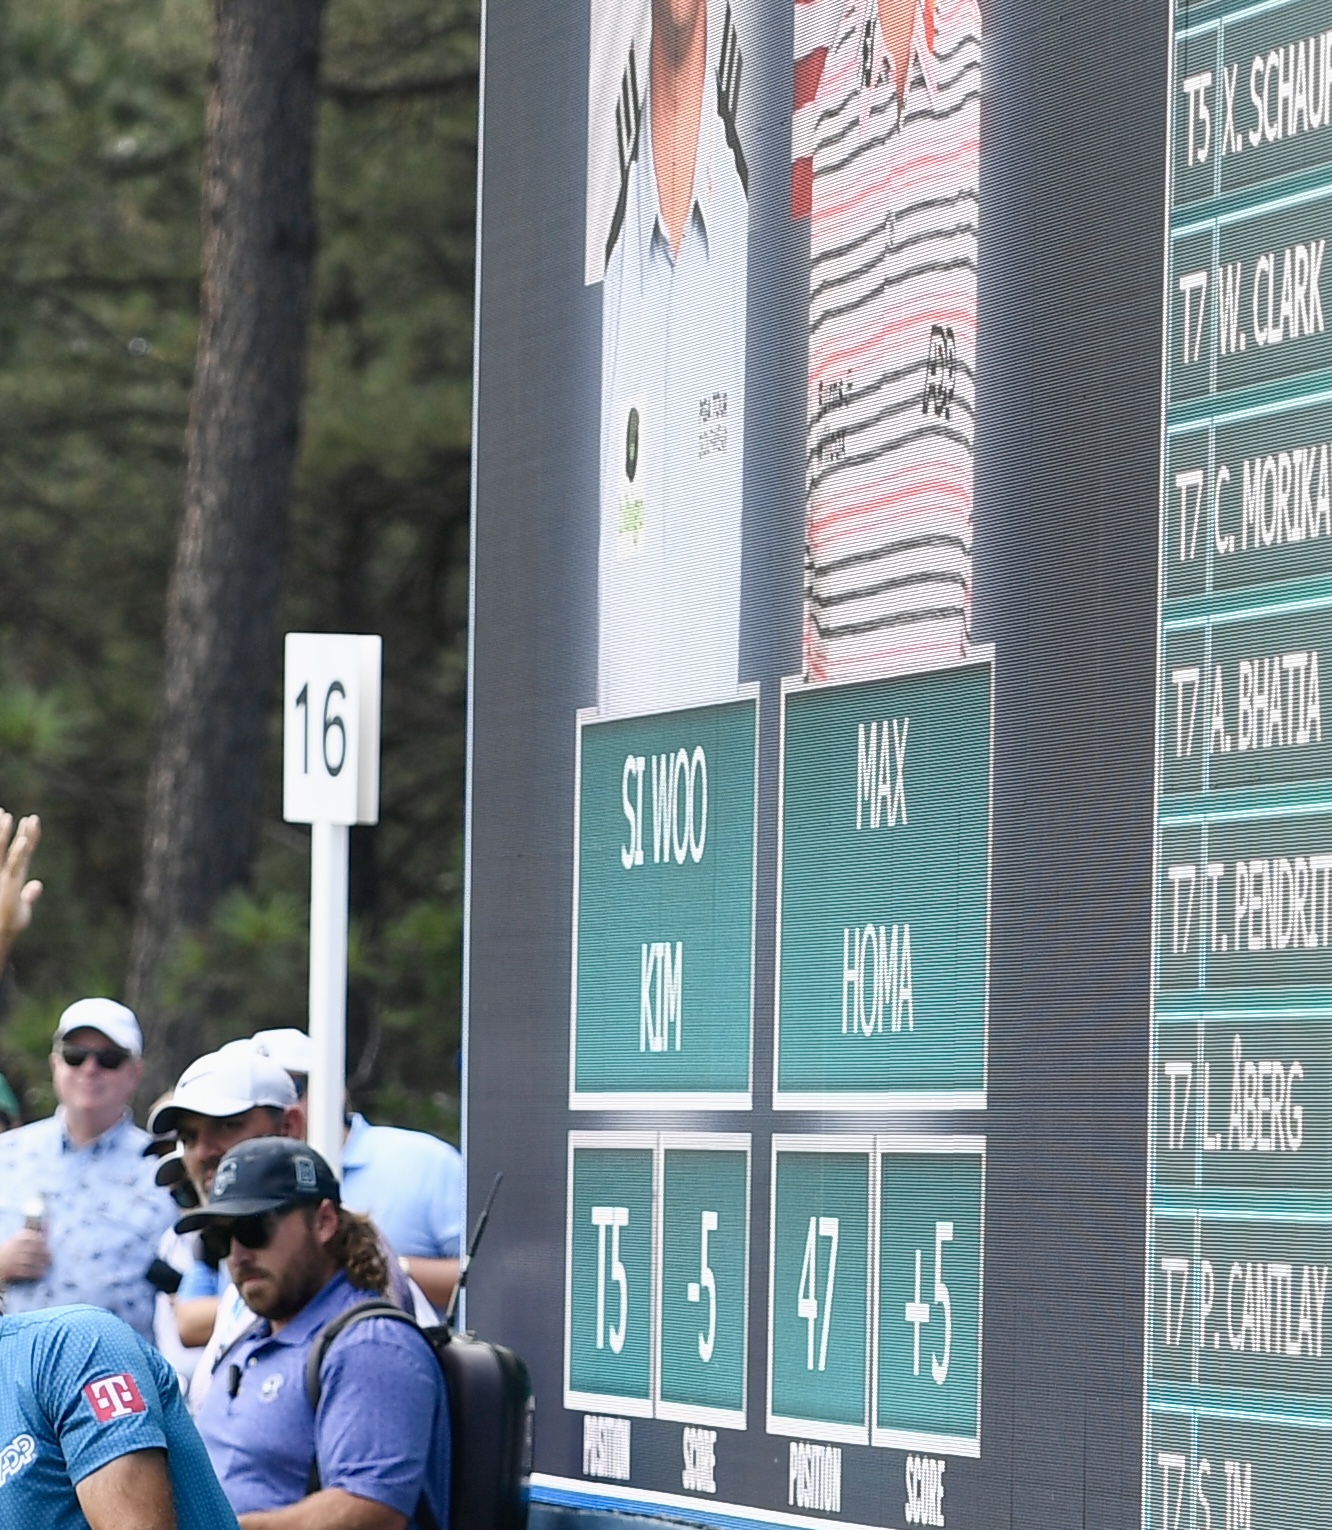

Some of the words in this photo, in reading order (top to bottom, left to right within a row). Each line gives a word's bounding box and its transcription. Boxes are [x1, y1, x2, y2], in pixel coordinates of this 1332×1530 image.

[1183, 70, 1213, 167] T5
[1222, 63, 1243, 156] X.
[1179, 271, 1208, 364] T7
[1219, 261, 1246, 355] W.
[1253, 239, 1325, 346] CLARK
[1175, 469, 1204, 560] T7
[1215, 464, 1235, 553] C.
[295, 680, 347, 777] 16
[1171, 667, 1200, 757] T7
[1211, 665, 1232, 752] A.
[1238, 651, 1322, 751] BHATIA
[621, 752, 647, 869] SI
[650, 745, 708, 865] WOO
[856, 717, 910, 830] MAX
[1168, 864, 1196, 953] T7
[1207, 863, 1228, 951] T.
[639, 941, 683, 1051] KIM
[841, 923, 914, 1037] HOMA
[1164, 1061, 1193, 1150] T7
[1203, 1062, 1222, 1150] L.
[591, 1206, 630, 1354] T5
[687, 1210, 719, 1362] -5
[798, 1216, 839, 1371] 47
[904, 1221, 954, 1385] +5
[1161, 1258, 1189, 1345] T7
[1201, 1260, 1221, 1349] P.
[1227, 1261, 1329, 1356] CANTLAY
[583, 1415, 632, 1481] POSITION
[682, 1426, 717, 1493] SCORE
[788, 1441, 842, 1513] POSITION
[904, 1454, 946, 1527] SCORE
